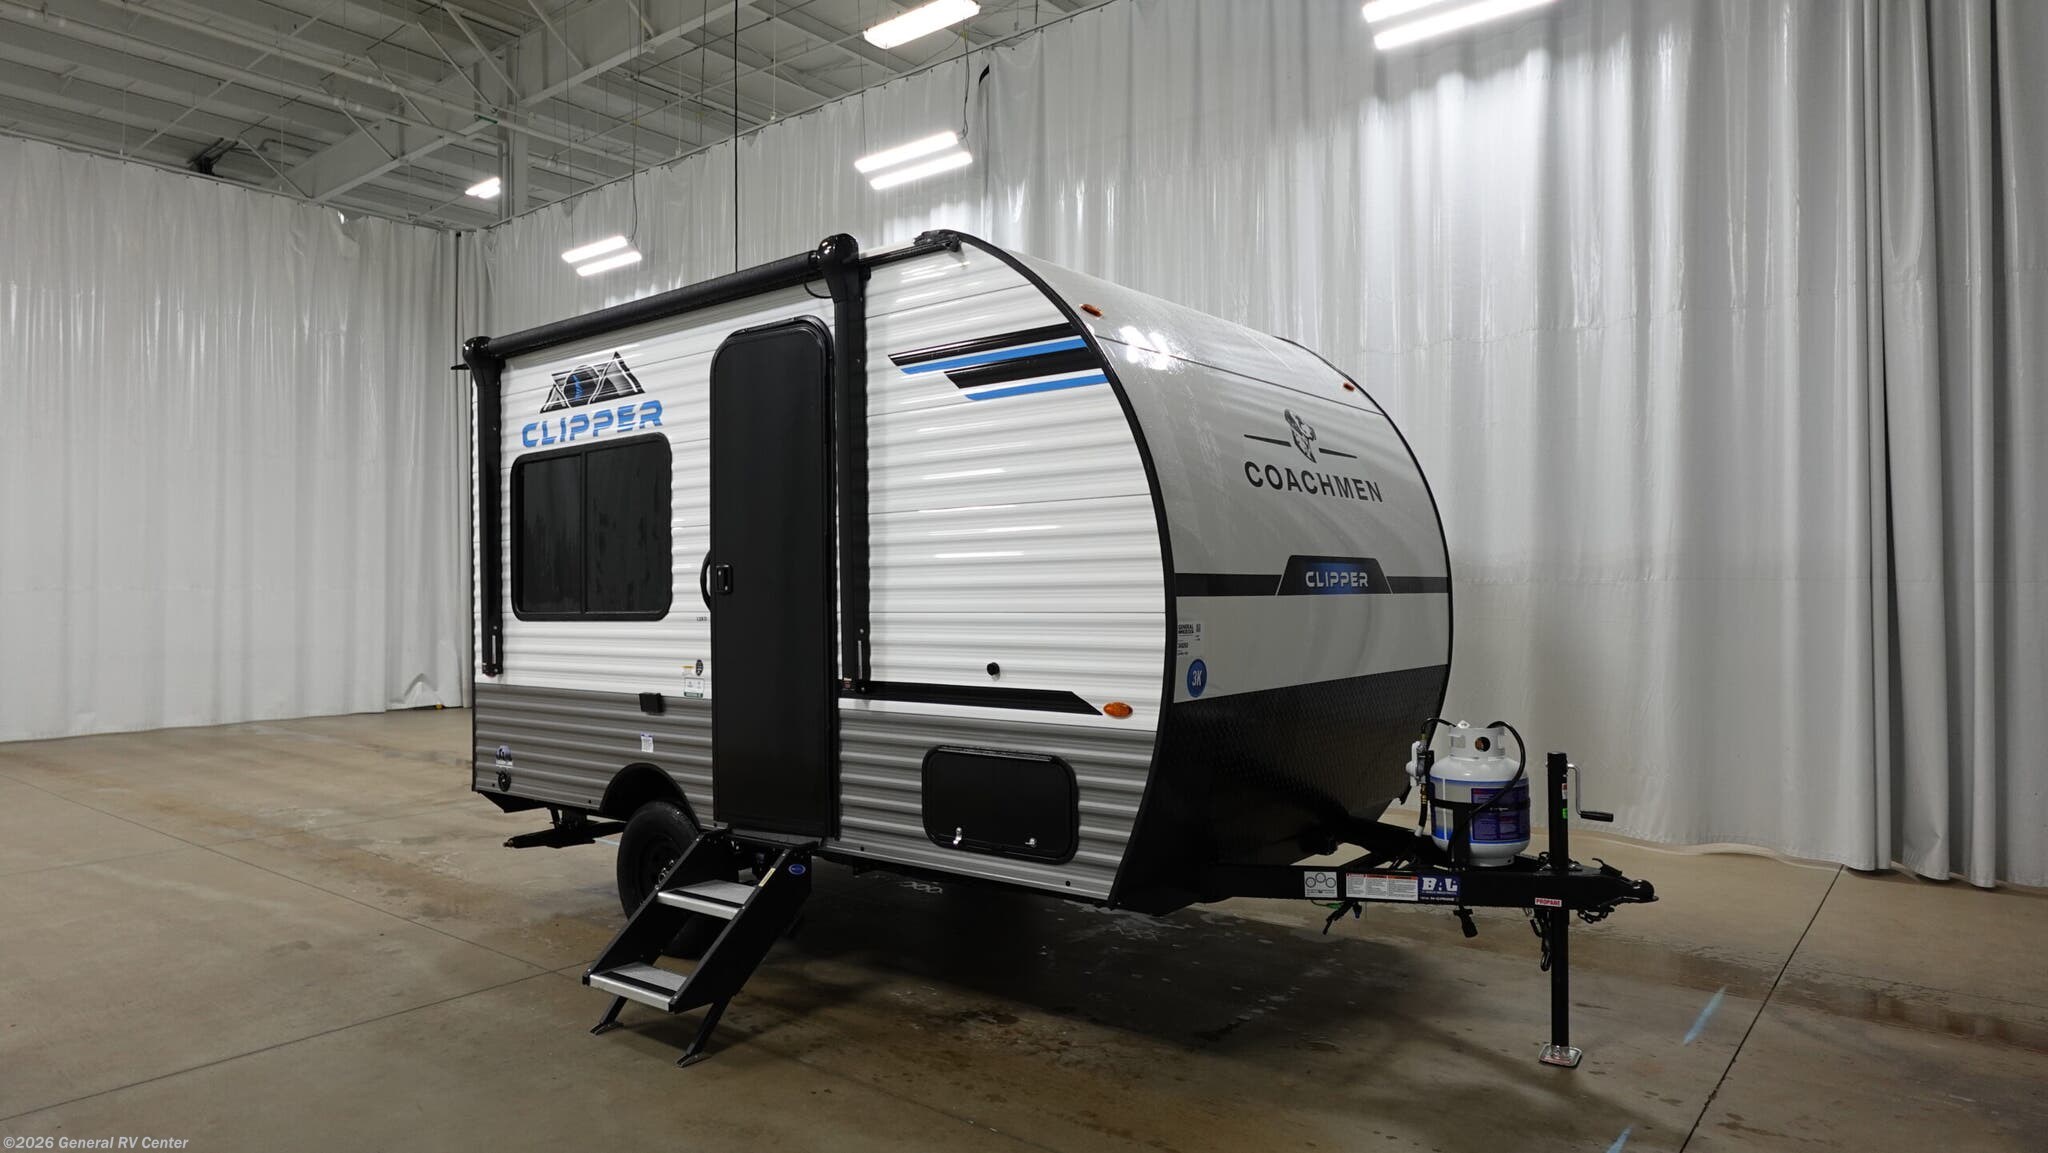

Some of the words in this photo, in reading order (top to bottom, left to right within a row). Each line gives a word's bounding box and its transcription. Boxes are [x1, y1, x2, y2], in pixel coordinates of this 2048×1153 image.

[522, 400, 664, 448] CLIPPER
[1244, 461, 1383, 503] COACHMEN
[1305, 571, 1369, 588] CLIPPER
[1191, 670, 1203, 686] 3K
[1536, 898, 1561, 906] PROPANE
